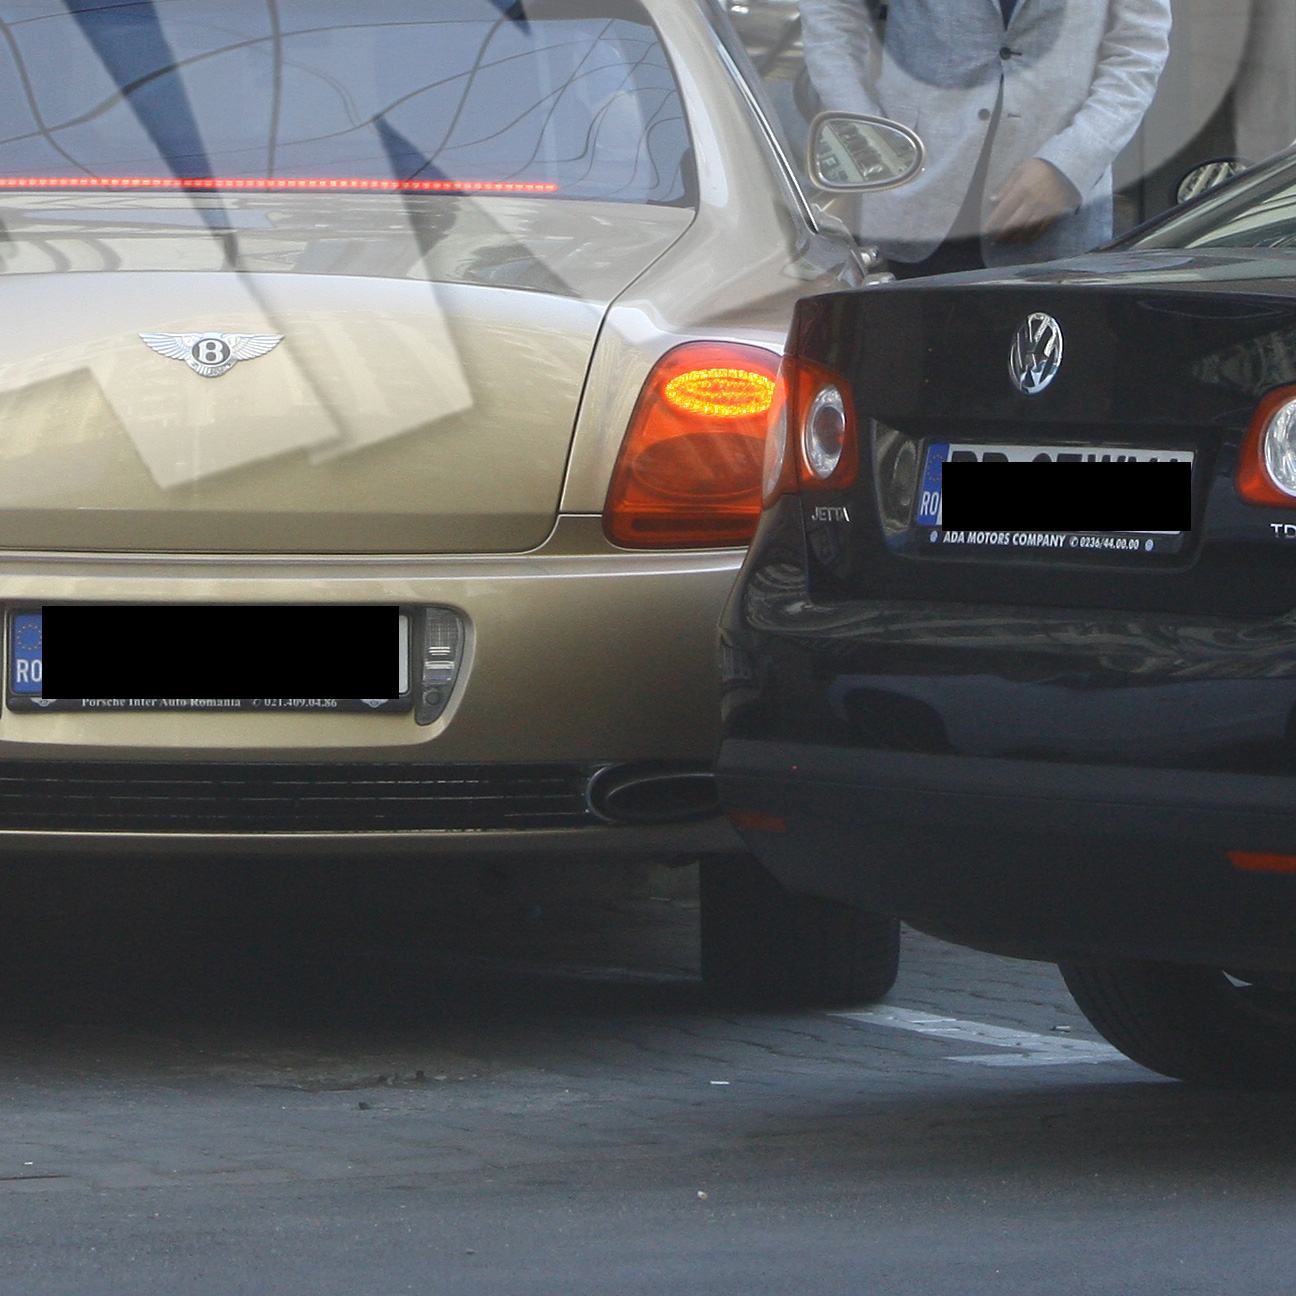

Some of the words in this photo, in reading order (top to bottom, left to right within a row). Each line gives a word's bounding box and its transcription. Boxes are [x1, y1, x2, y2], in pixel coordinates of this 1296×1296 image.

[920, 490, 940, 516] RO
[811, 506, 850, 522] JETTA
[943, 531, 965, 544] ADA
[967, 531, 1010, 545] MOTORS
[1012, 532, 1066, 548] COMPANY
[15, 658, 42, 683] RO
[190, 698, 241, 707] Romania
